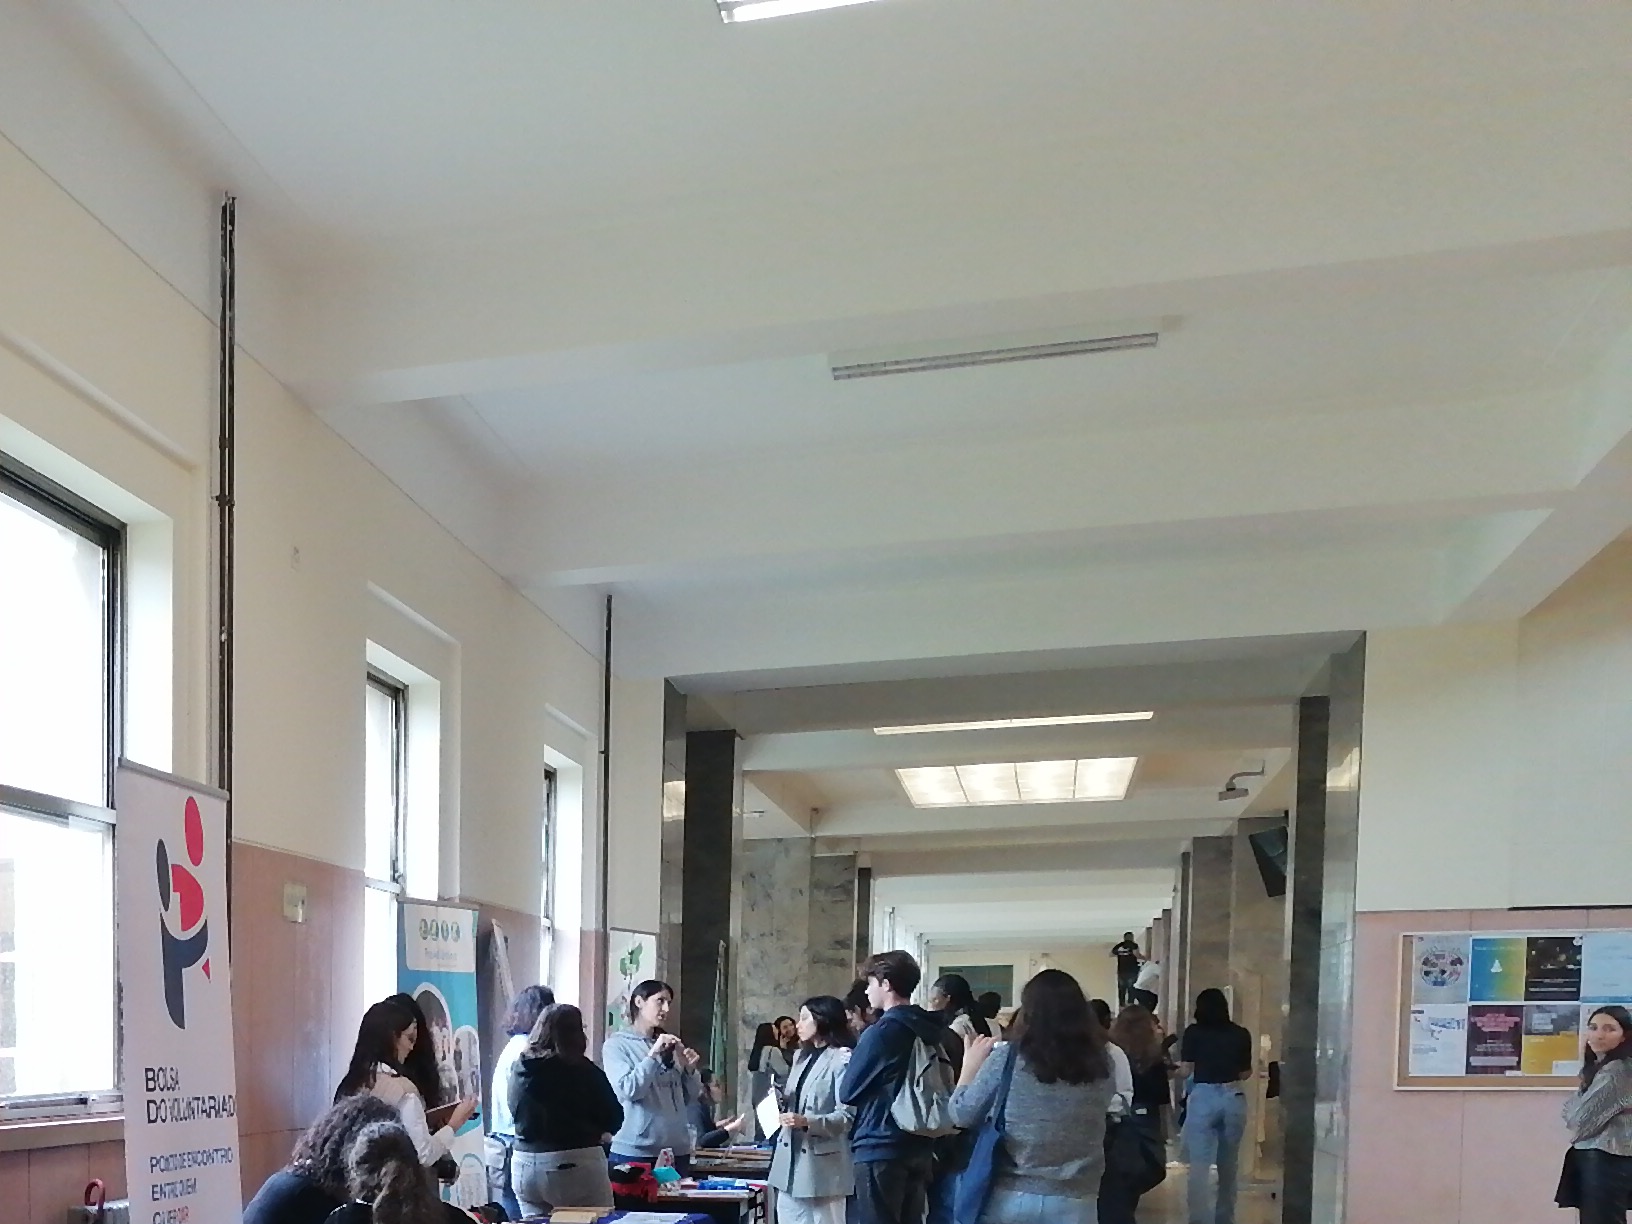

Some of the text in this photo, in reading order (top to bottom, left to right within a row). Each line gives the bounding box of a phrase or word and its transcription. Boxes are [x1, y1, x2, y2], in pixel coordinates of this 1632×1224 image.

[145, 1066, 180, 1092] BOLSA
[147, 1094, 236, 1124] DO VOLUNTARIADO
